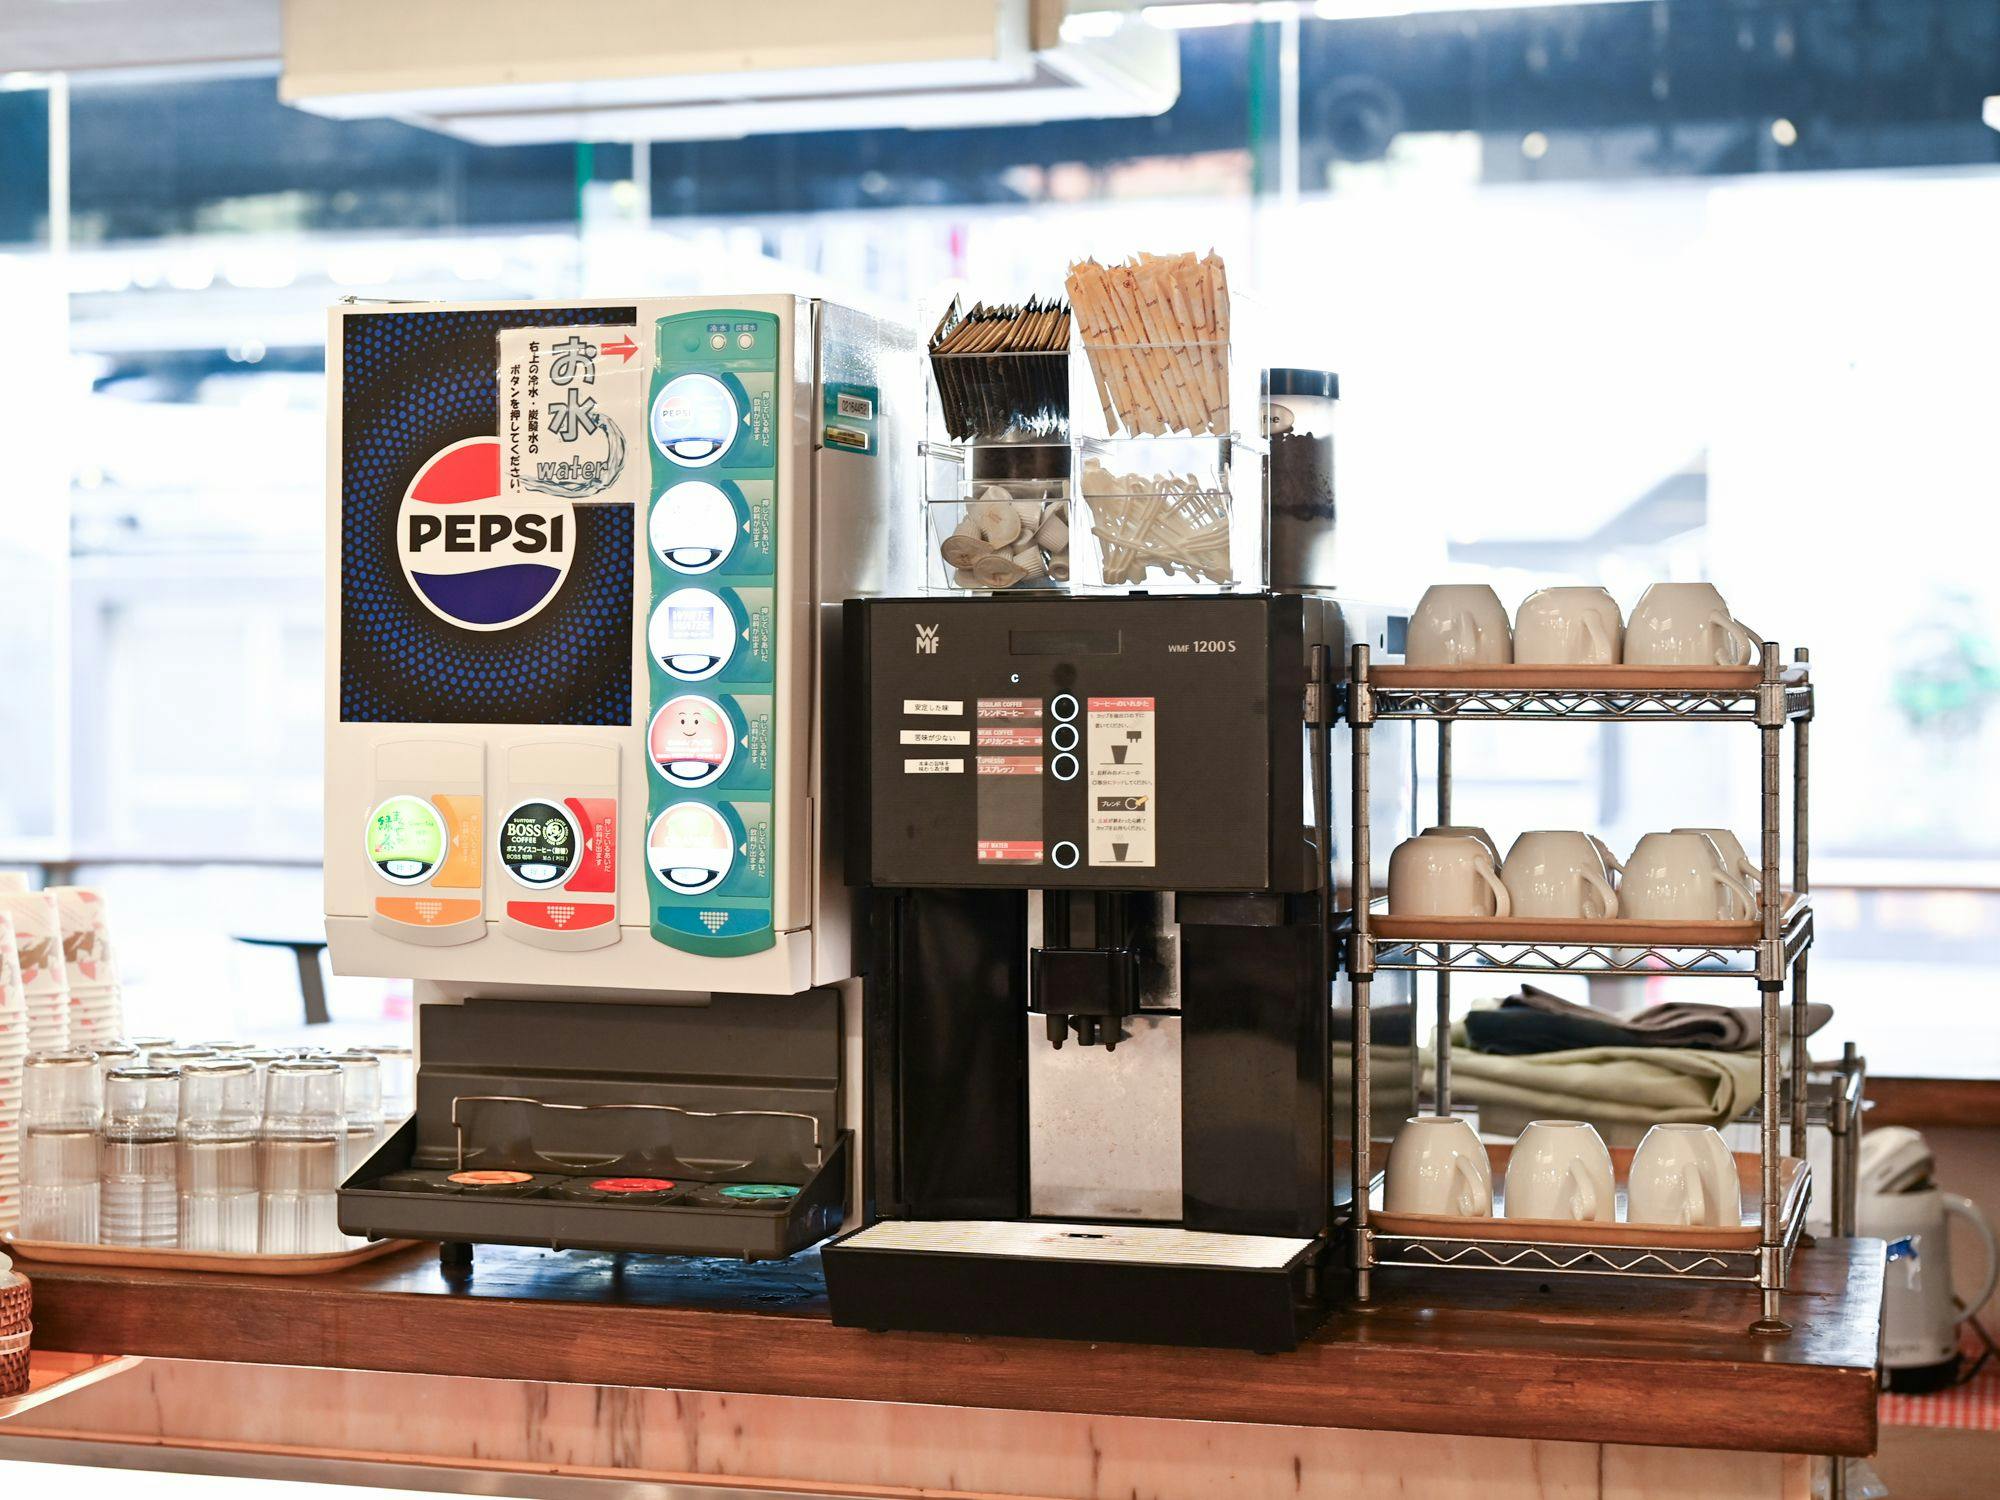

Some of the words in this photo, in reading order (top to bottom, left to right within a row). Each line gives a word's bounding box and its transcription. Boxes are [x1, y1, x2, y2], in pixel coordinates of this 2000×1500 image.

[528, 341, 540, 454] 右上の冷水・炭酸水の
[548, 336, 598, 443] お水
[510, 364, 521, 494] ボタンを押してください。
[536, 455, 609, 481] water
[409, 513, 564, 554] PEPSI
[1168, 644, 1190, 653] WMF
[1193, 640, 1226, 653] 1200
[914, 704, 949, 712] 安定した味
[914, 733, 957, 742] 苦味が少ない
[977, 738, 1031, 746] アメリカンコーヒー
[507, 823, 541, 837] BOSS
[511, 836, 538, 844] COFFEE
[603, 818, 612, 873] 押しているあいだ
